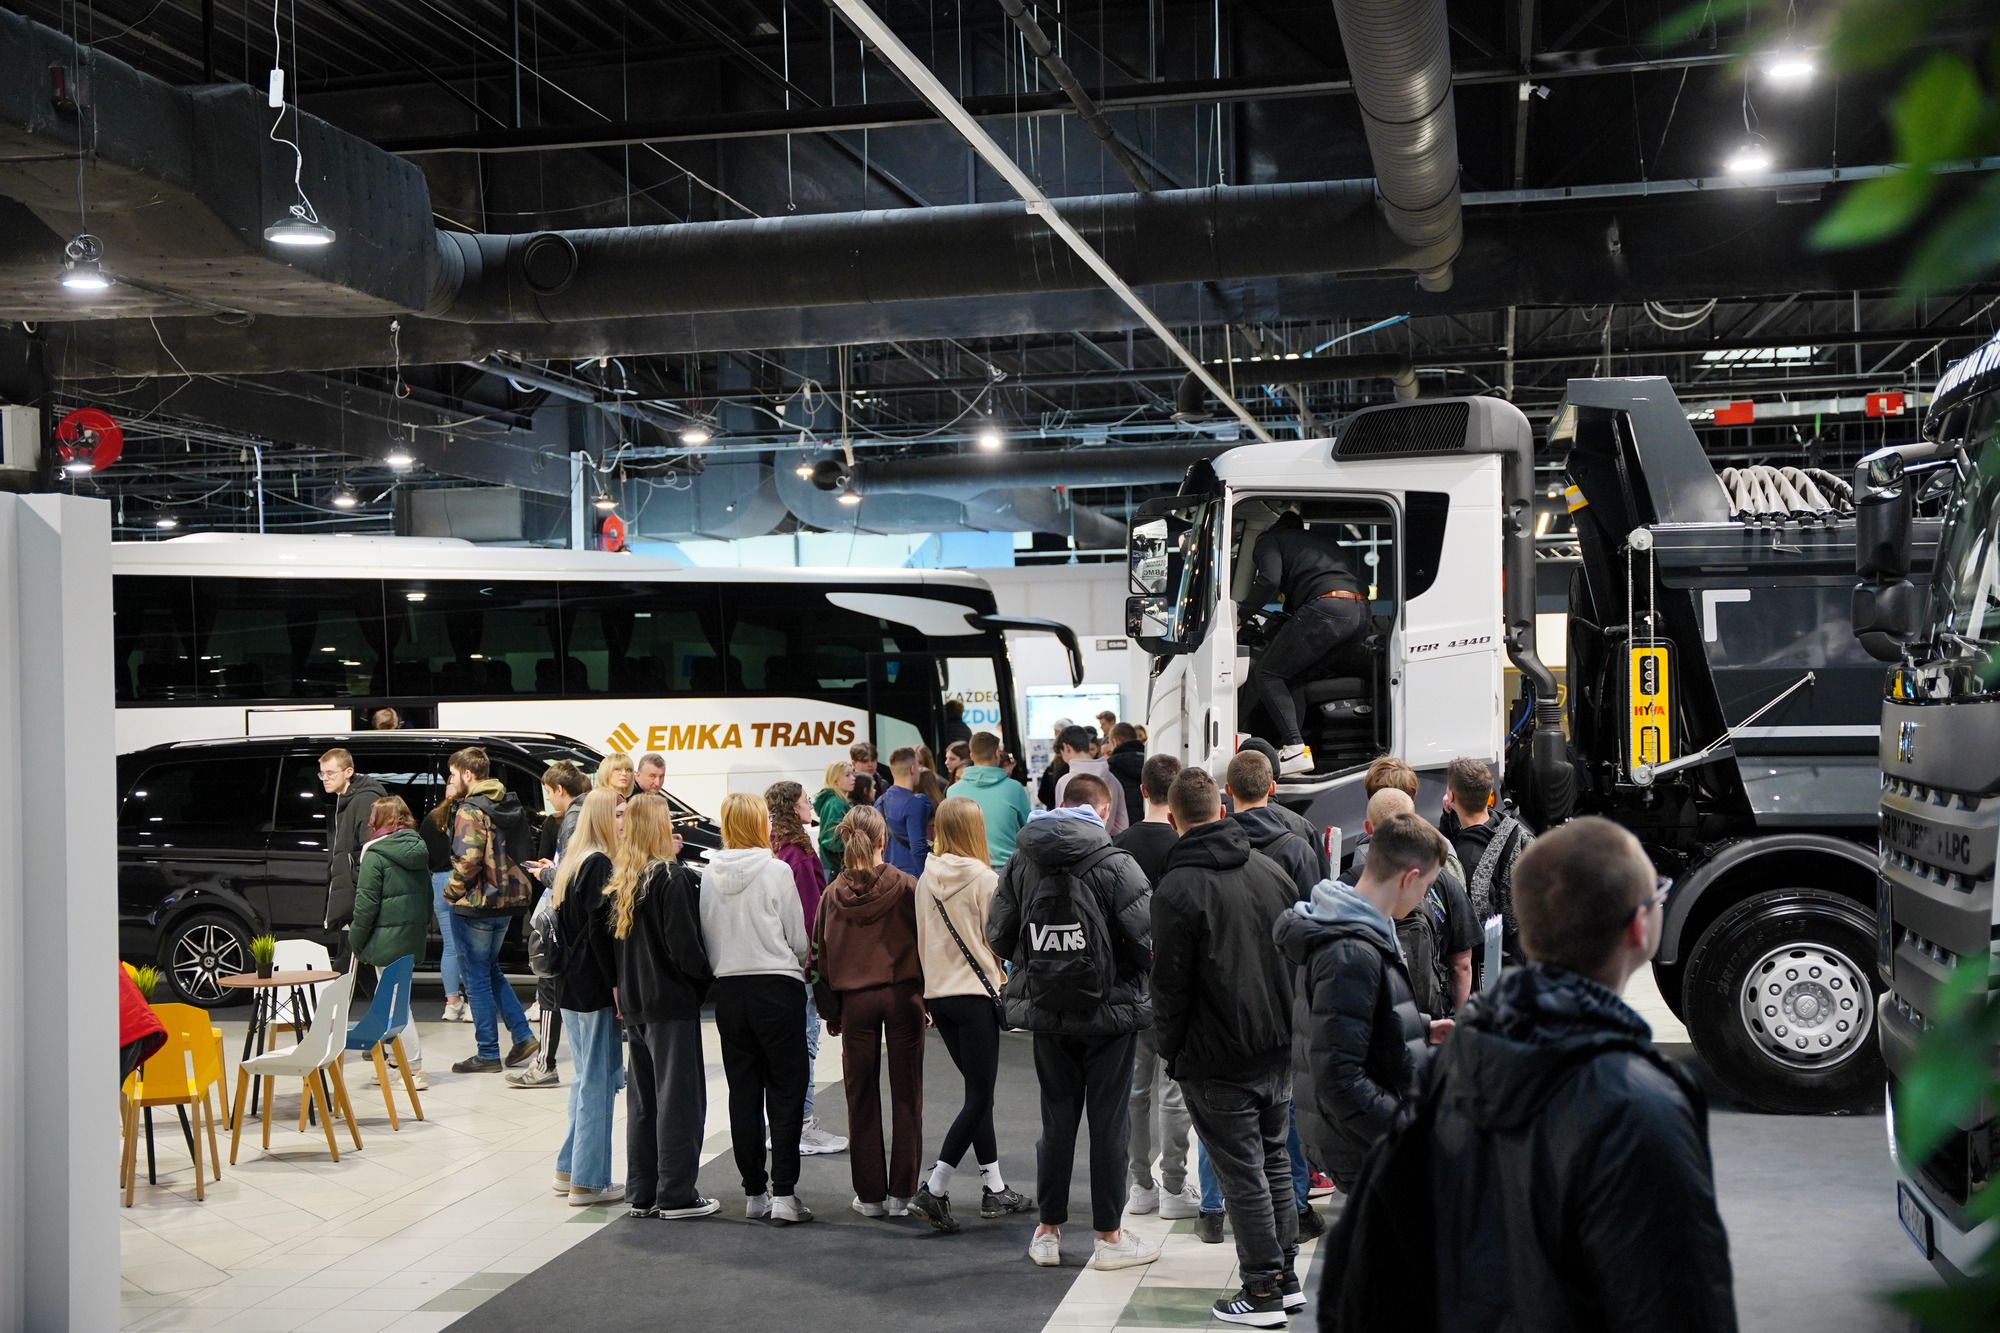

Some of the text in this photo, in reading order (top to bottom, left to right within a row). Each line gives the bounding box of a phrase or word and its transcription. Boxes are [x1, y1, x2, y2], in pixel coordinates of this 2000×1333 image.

[1408, 636, 1491, 654] TGR 4340
[646, 720, 856, 751] EMKA TRANS
[1945, 831, 1970, 865] LPG
[1029, 921, 1086, 951] VANS
